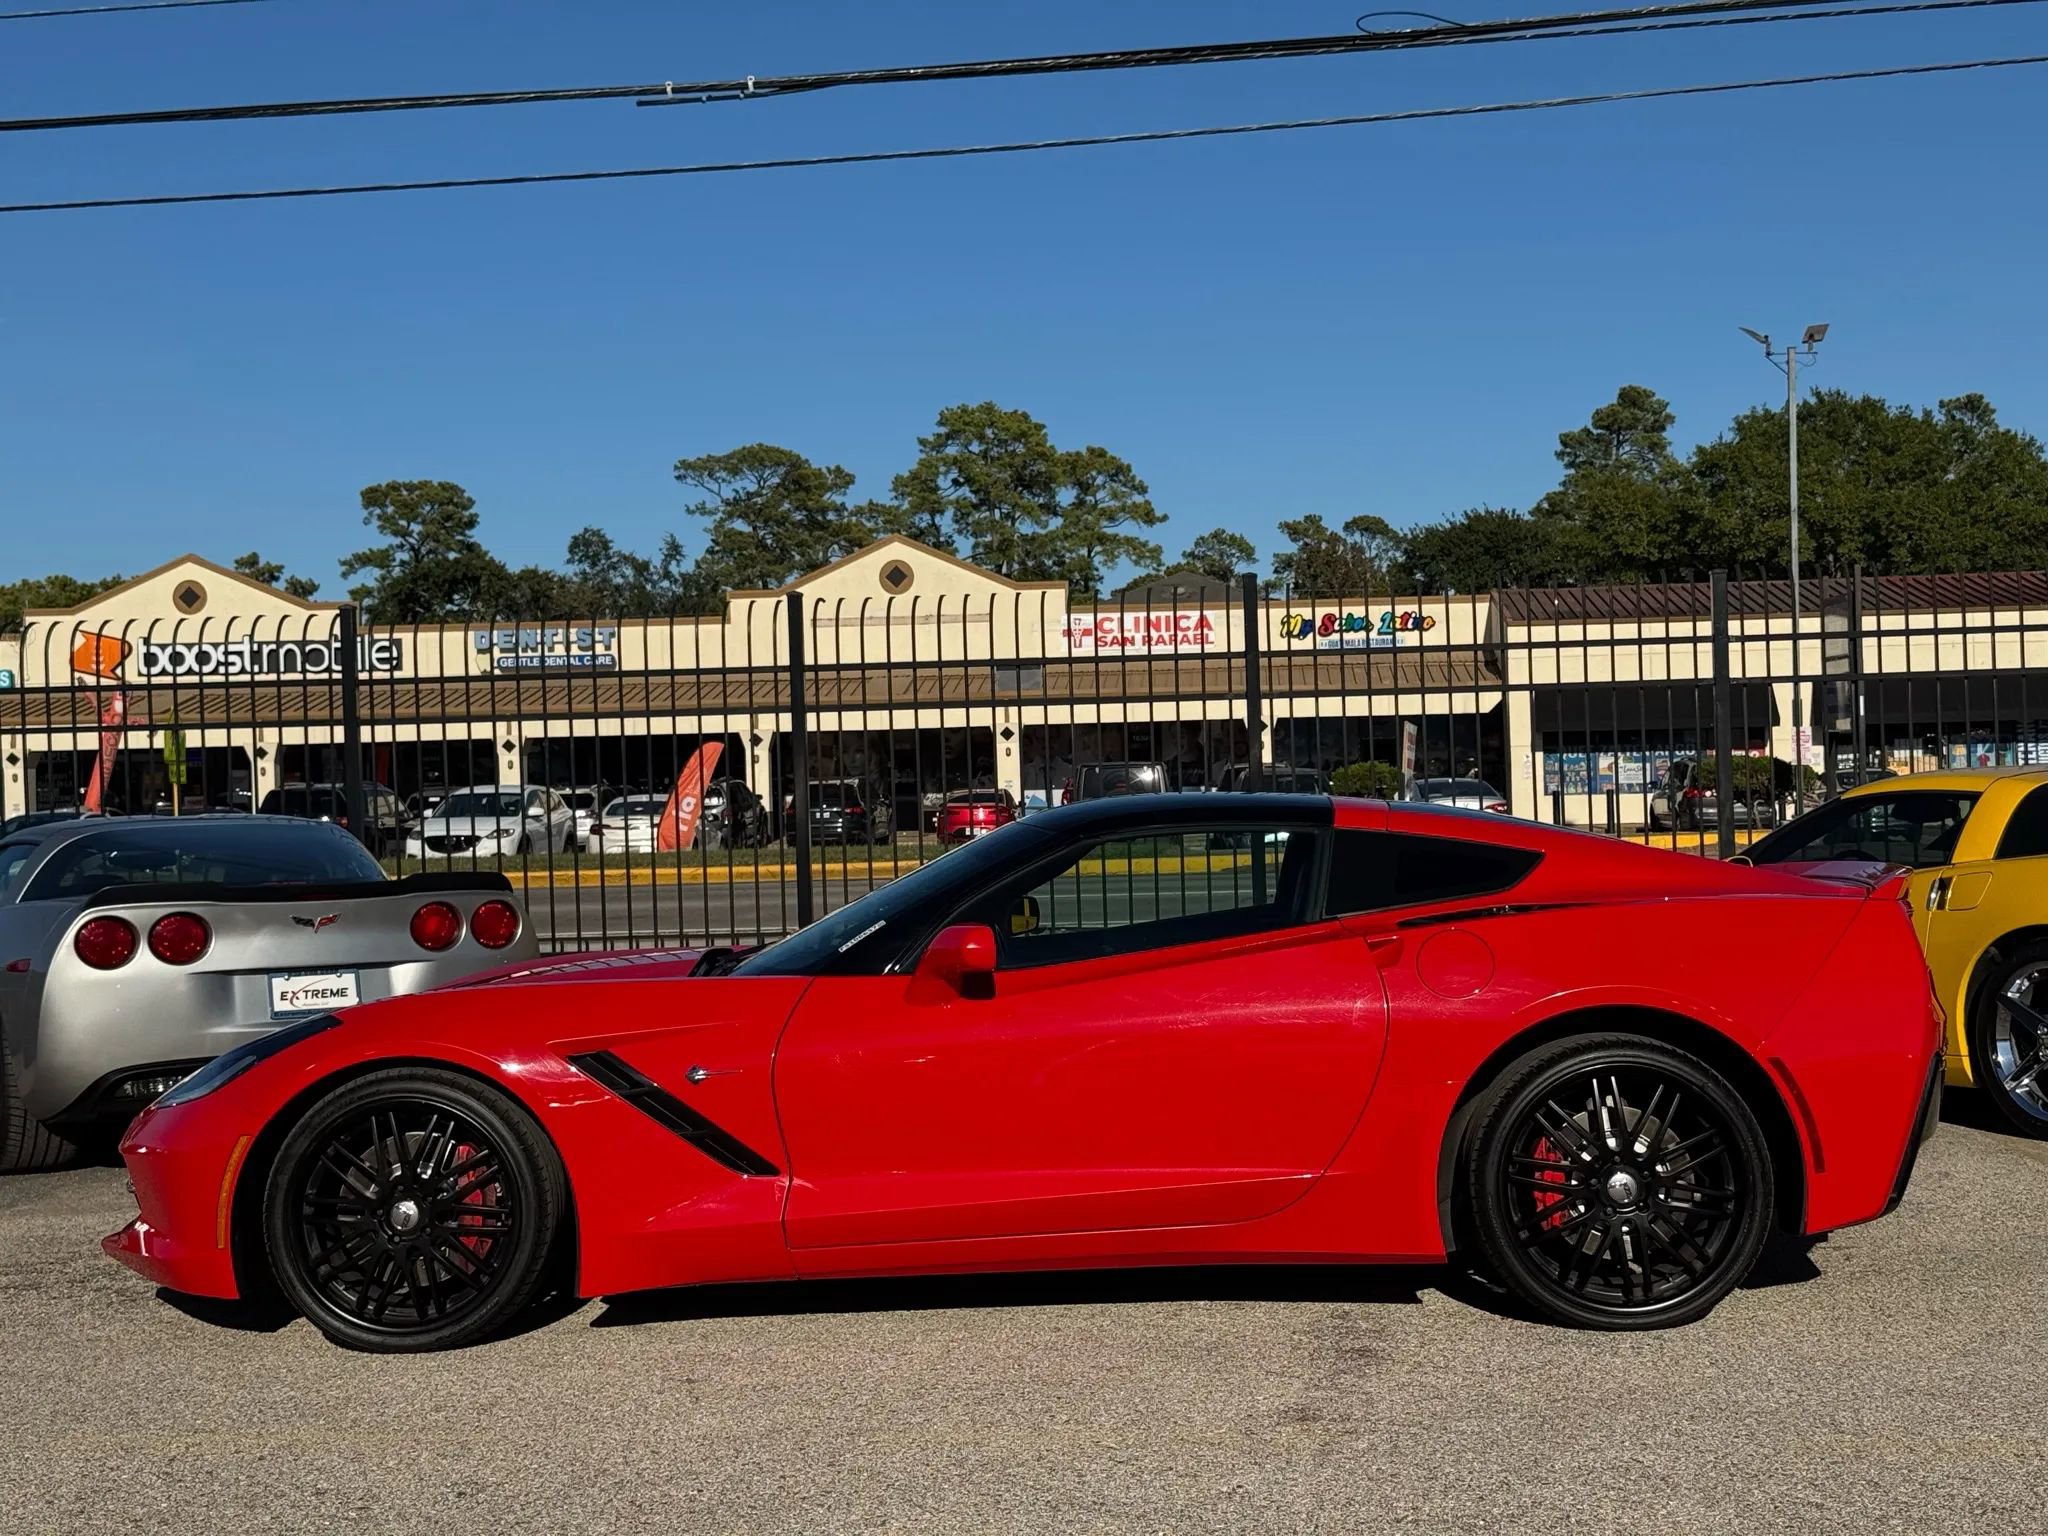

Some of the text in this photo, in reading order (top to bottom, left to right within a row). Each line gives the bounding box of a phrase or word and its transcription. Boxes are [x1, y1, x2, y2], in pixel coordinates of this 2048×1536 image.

[1098, 634, 1136, 648] SAN
[500, 655, 613, 667] GENTLE DENTAL CARE
[280, 986, 349, 1003] EXTREME
